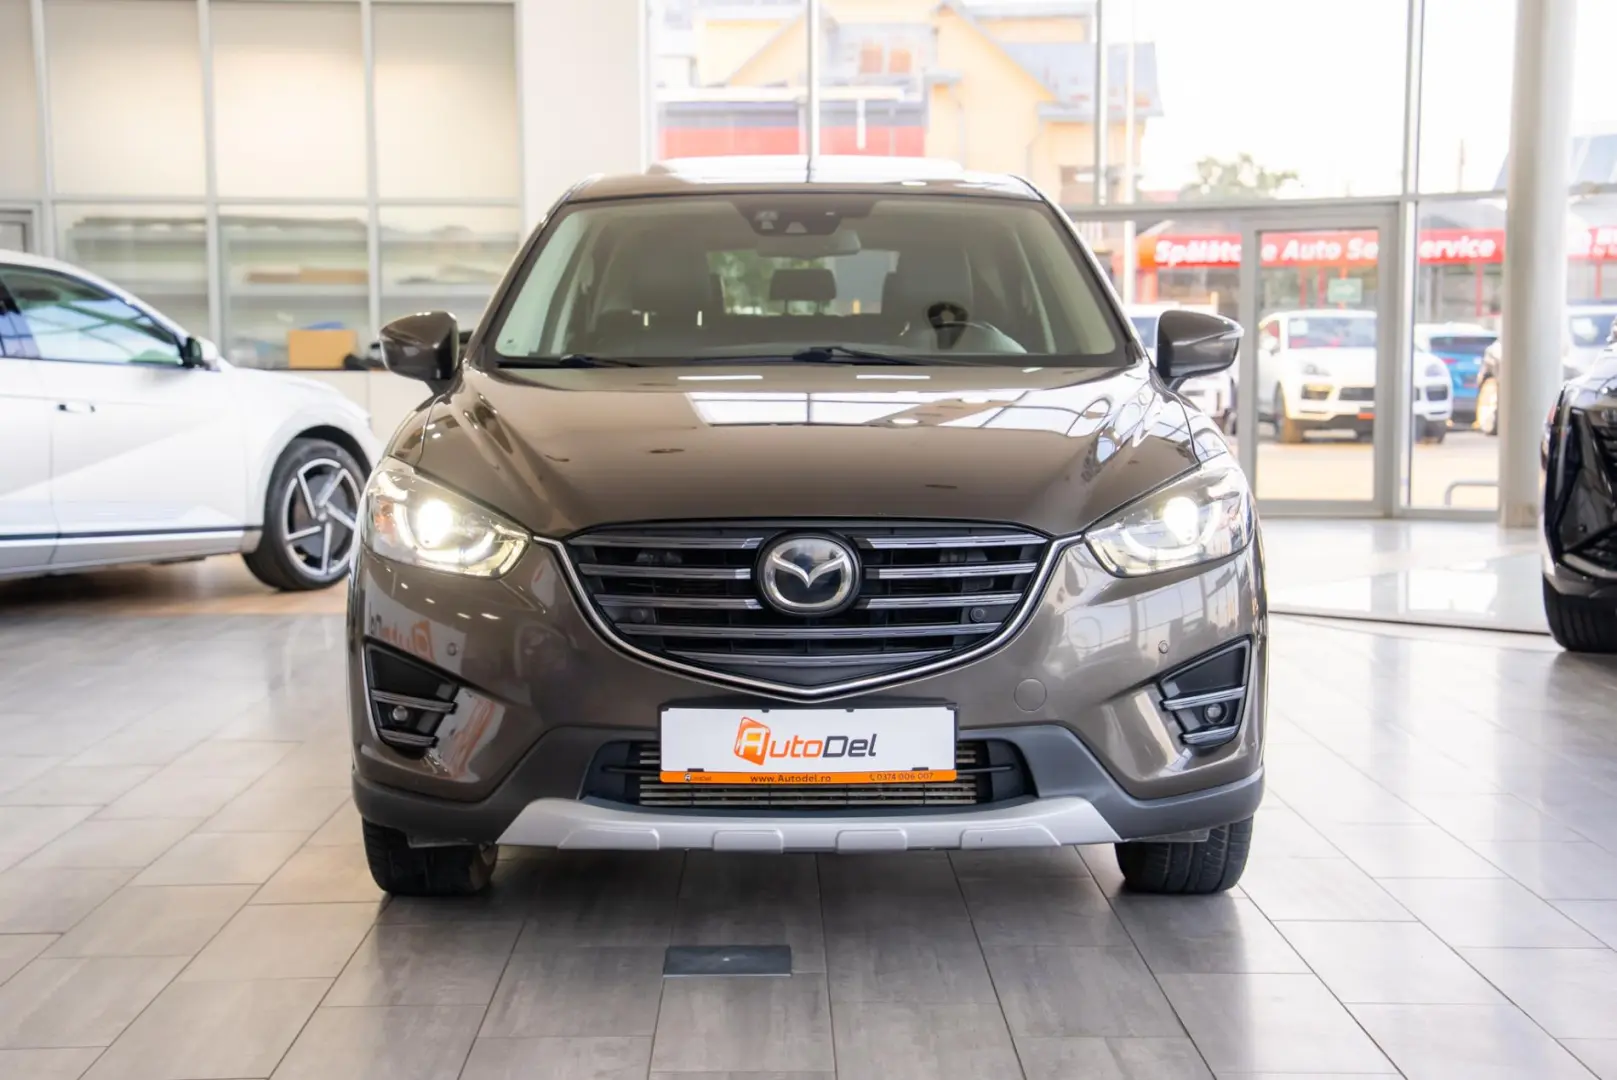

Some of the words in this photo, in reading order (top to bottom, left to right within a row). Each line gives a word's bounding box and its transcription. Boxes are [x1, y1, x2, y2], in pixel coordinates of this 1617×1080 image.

[1281, 240, 1341, 260] Auto
[733, 717, 877, 765] AutoDel
[750, 774, 832, 783] www.Autodel.ro
[876, 773, 896, 781] 0374
